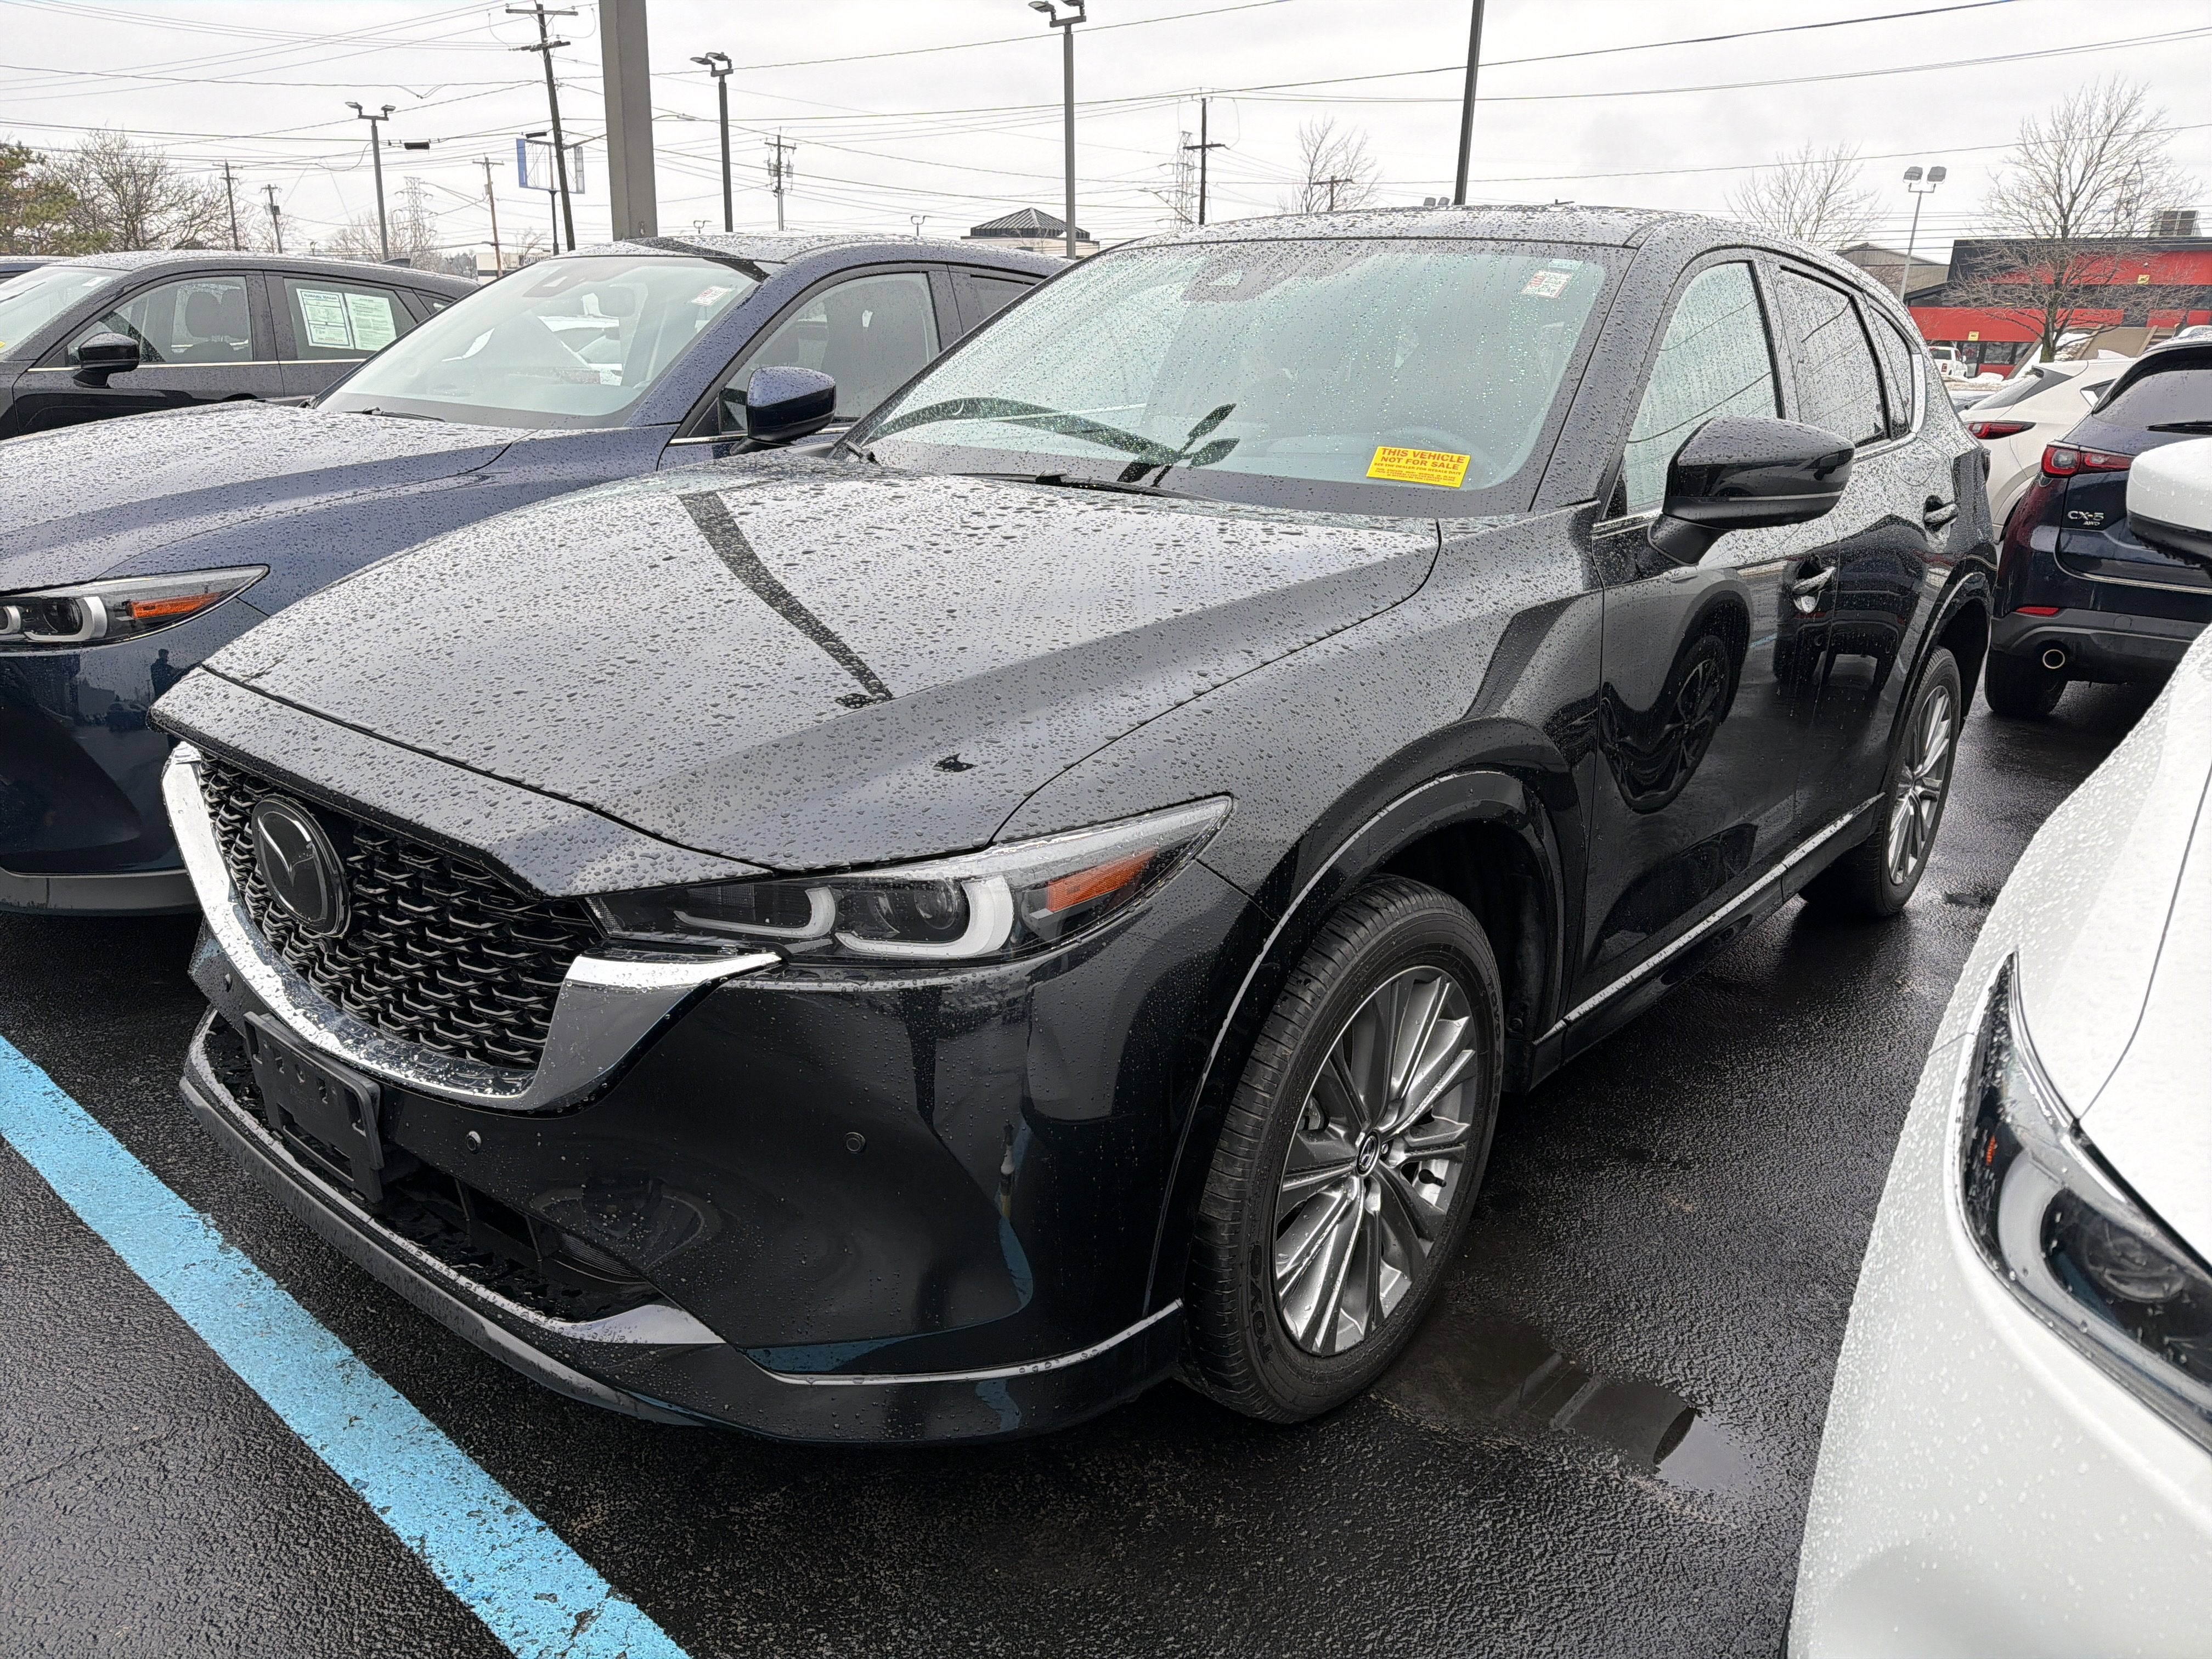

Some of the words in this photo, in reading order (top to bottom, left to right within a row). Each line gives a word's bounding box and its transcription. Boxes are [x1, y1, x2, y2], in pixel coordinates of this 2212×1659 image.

[1382, 448, 1409, 457] THIS
[1413, 451, 1466, 464] VEHICLE
[1431, 462, 1460, 470] SALE
[2068, 510, 2104, 521] CX-5
[1250, 1244, 1273, 1364] TOYO
